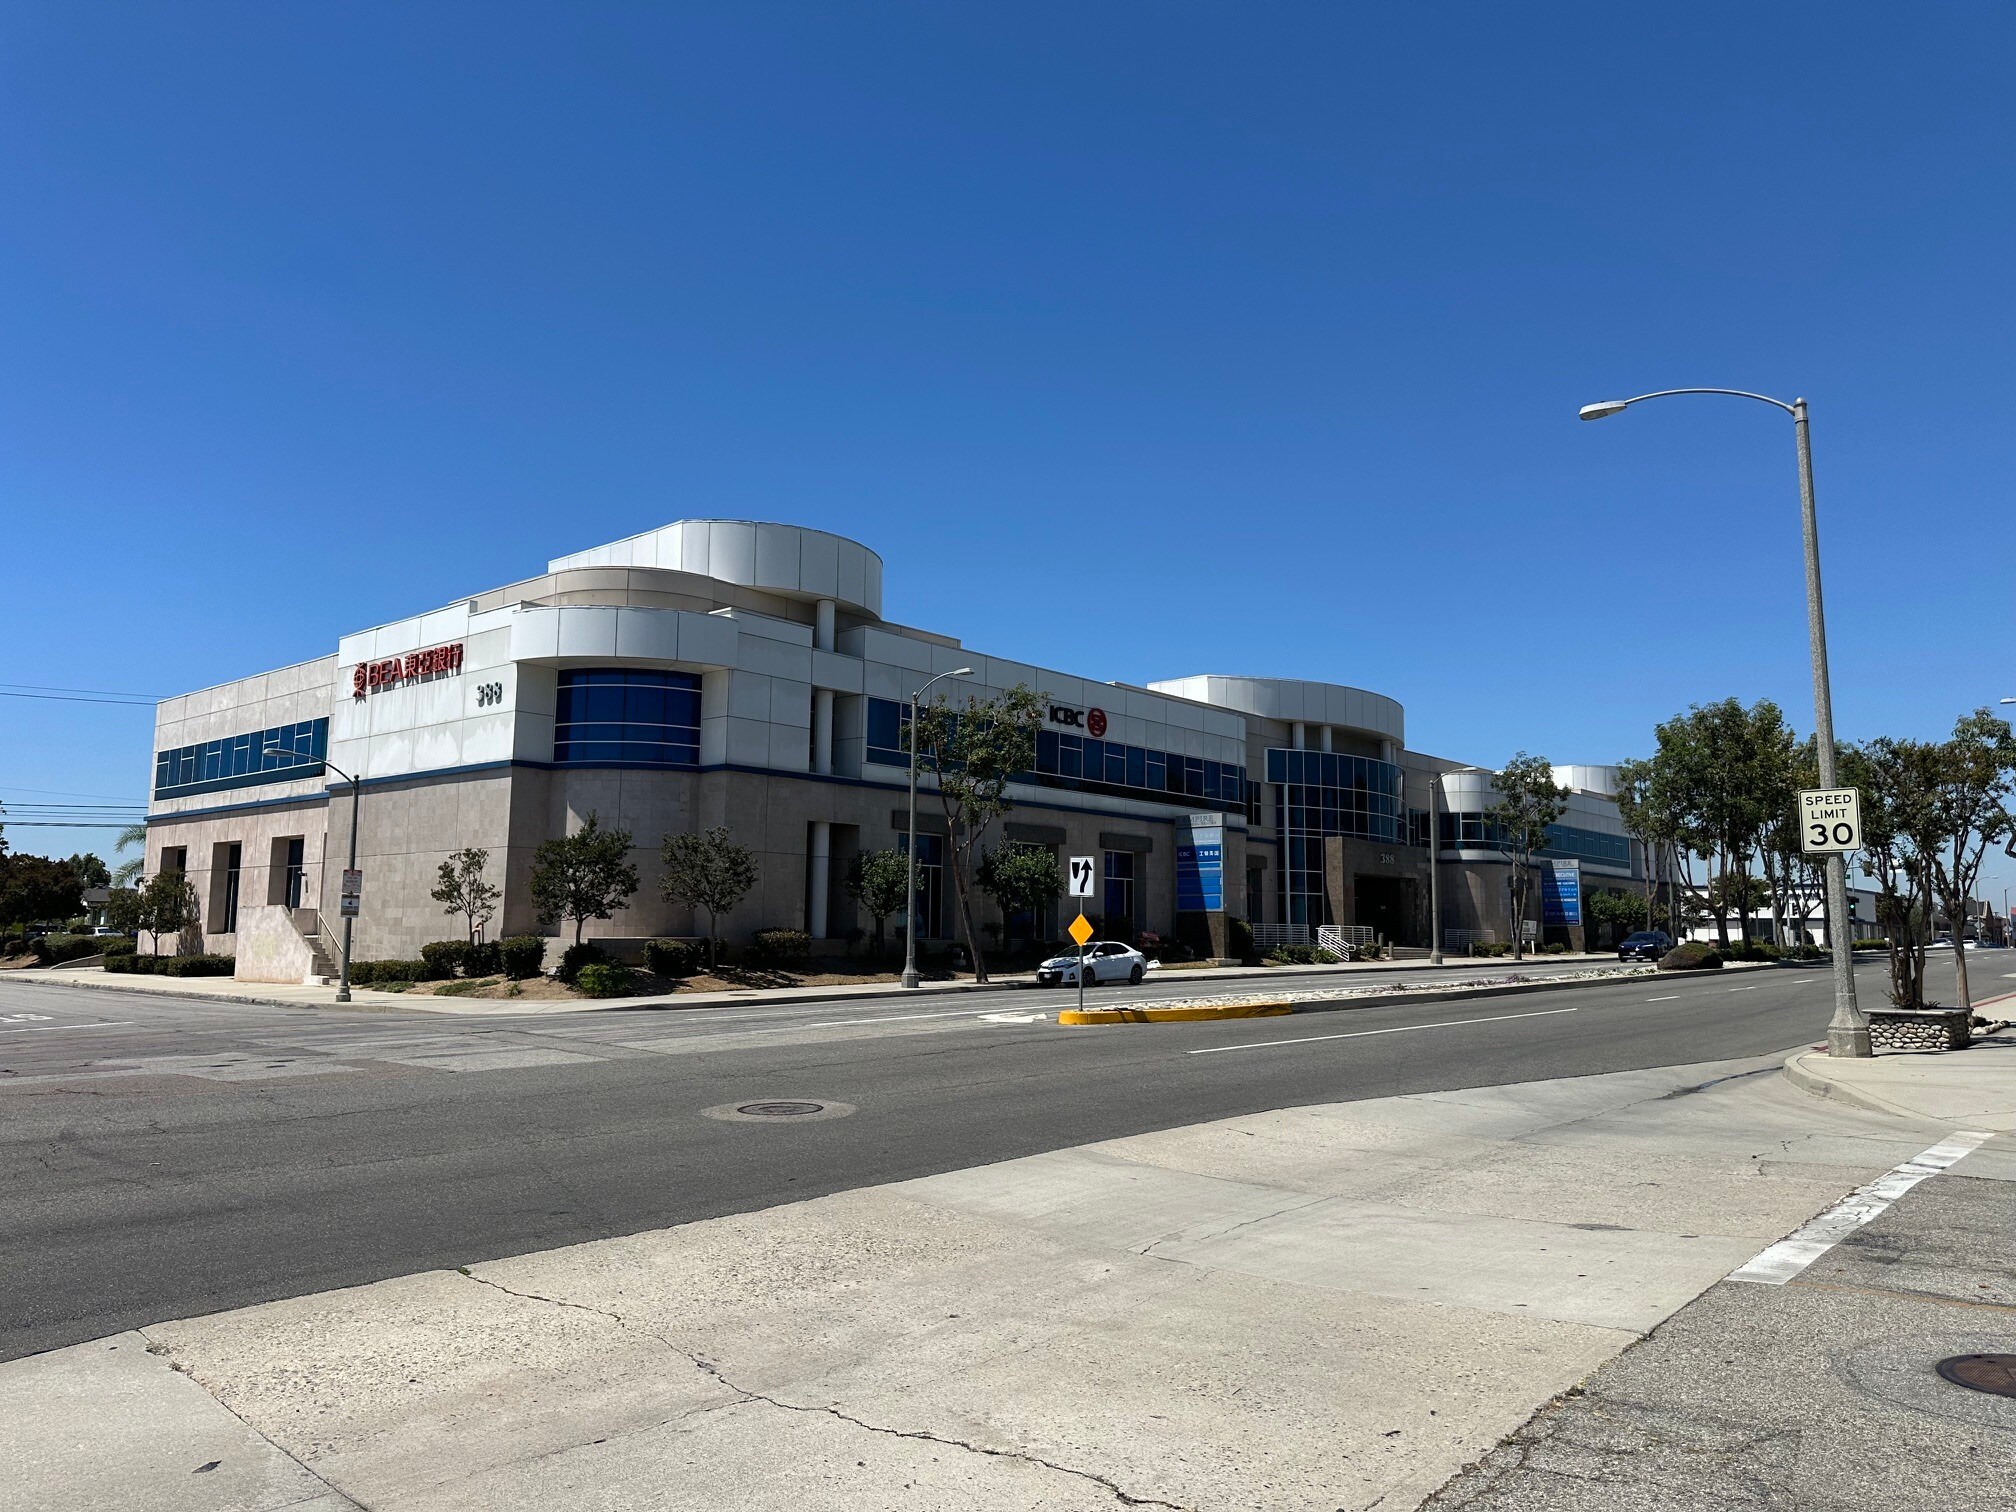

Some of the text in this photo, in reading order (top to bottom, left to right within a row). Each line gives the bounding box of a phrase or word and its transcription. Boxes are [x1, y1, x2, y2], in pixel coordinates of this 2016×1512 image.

[367, 643, 464, 687] BEA 東亞銀行
[476, 681, 502, 701] 388
[1049, 705, 1085, 728] ICBC
[1805, 794, 1852, 806] SPEED
[1811, 808, 1847, 819] LIMIT
[1809, 822, 1854, 846] 30
[1380, 853, 1395, 865] 388
